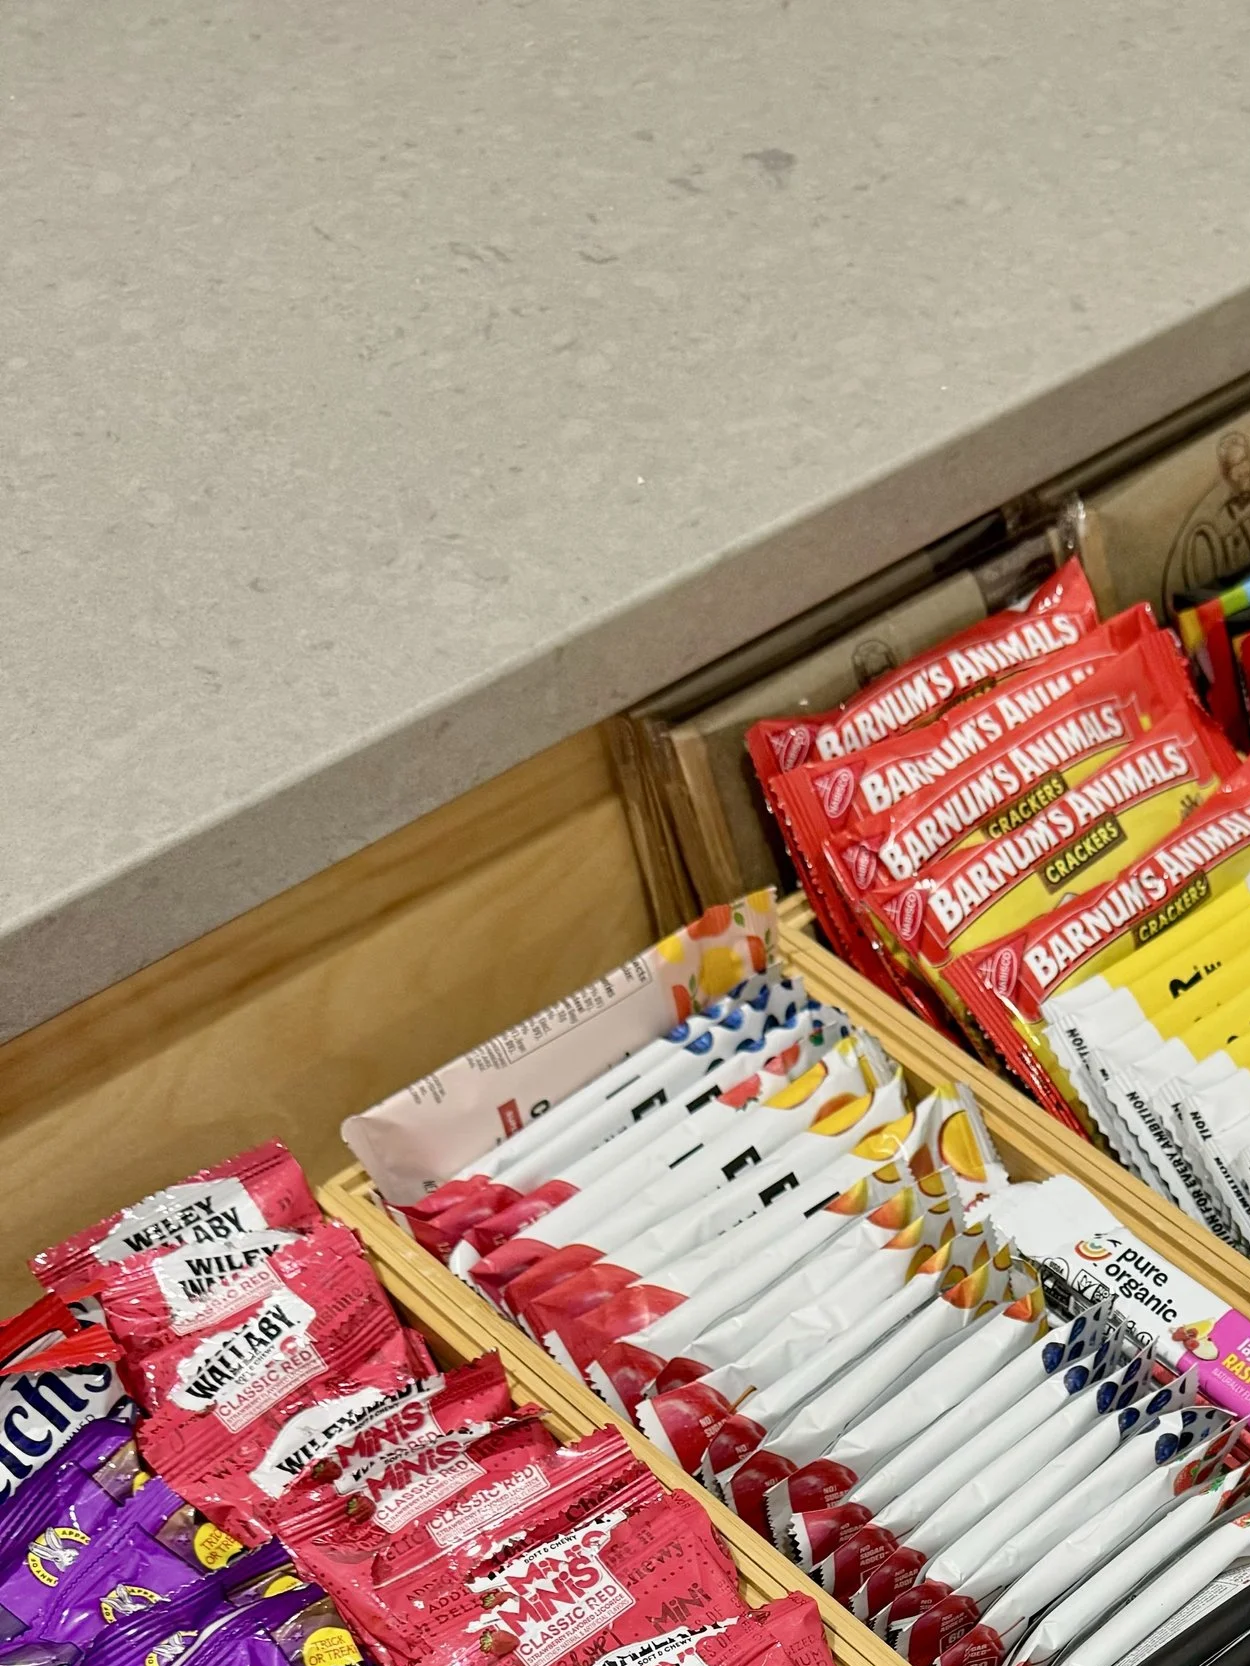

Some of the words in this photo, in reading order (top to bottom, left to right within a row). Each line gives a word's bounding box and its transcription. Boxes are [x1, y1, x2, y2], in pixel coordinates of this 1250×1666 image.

[815, 665, 954, 761] BARNUM'S
[946, 613, 1080, 687] ANIMALS
[860, 712, 1002, 815] BARNUM'S
[1000, 664, 1097, 731] ANIM
[879, 763, 1020, 881] BARNUM'S
[1009, 704, 1125, 790] ANIMALS
[987, 777, 1066, 839] CRACKERS
[928, 810, 1077, 934] BARNUM'S
[1069, 743, 1190, 838] ANIMALS
[1044, 821, 1119, 885] CRACKERS
[1024, 868, 1167, 989] BARNUM'S
[1137, 874, 1208, 942] CRACKERS
[1104, 1262, 1178, 1324] organic
[1117, 1247, 1169, 1288] pure
[218, 1368, 280, 1417] CLASSIC
[281, 1348, 314, 1375] RED
[376, 1475, 441, 1521] CLASSIC
[441, 1459, 470, 1484] RED
[523, 1548, 544, 1565] SOFT
[549, 1533, 577, 1551] CHEWY
[519, 1604, 587, 1657] CLASSIC
[588, 1584, 618, 1609] RED
[526, 1629, 569, 1664] STRAWBERRY
[637, 1652, 657, 1666] SOFT
[663, 1637, 693, 1652] CHEWY
[308, 1650, 328, 1666] OR
